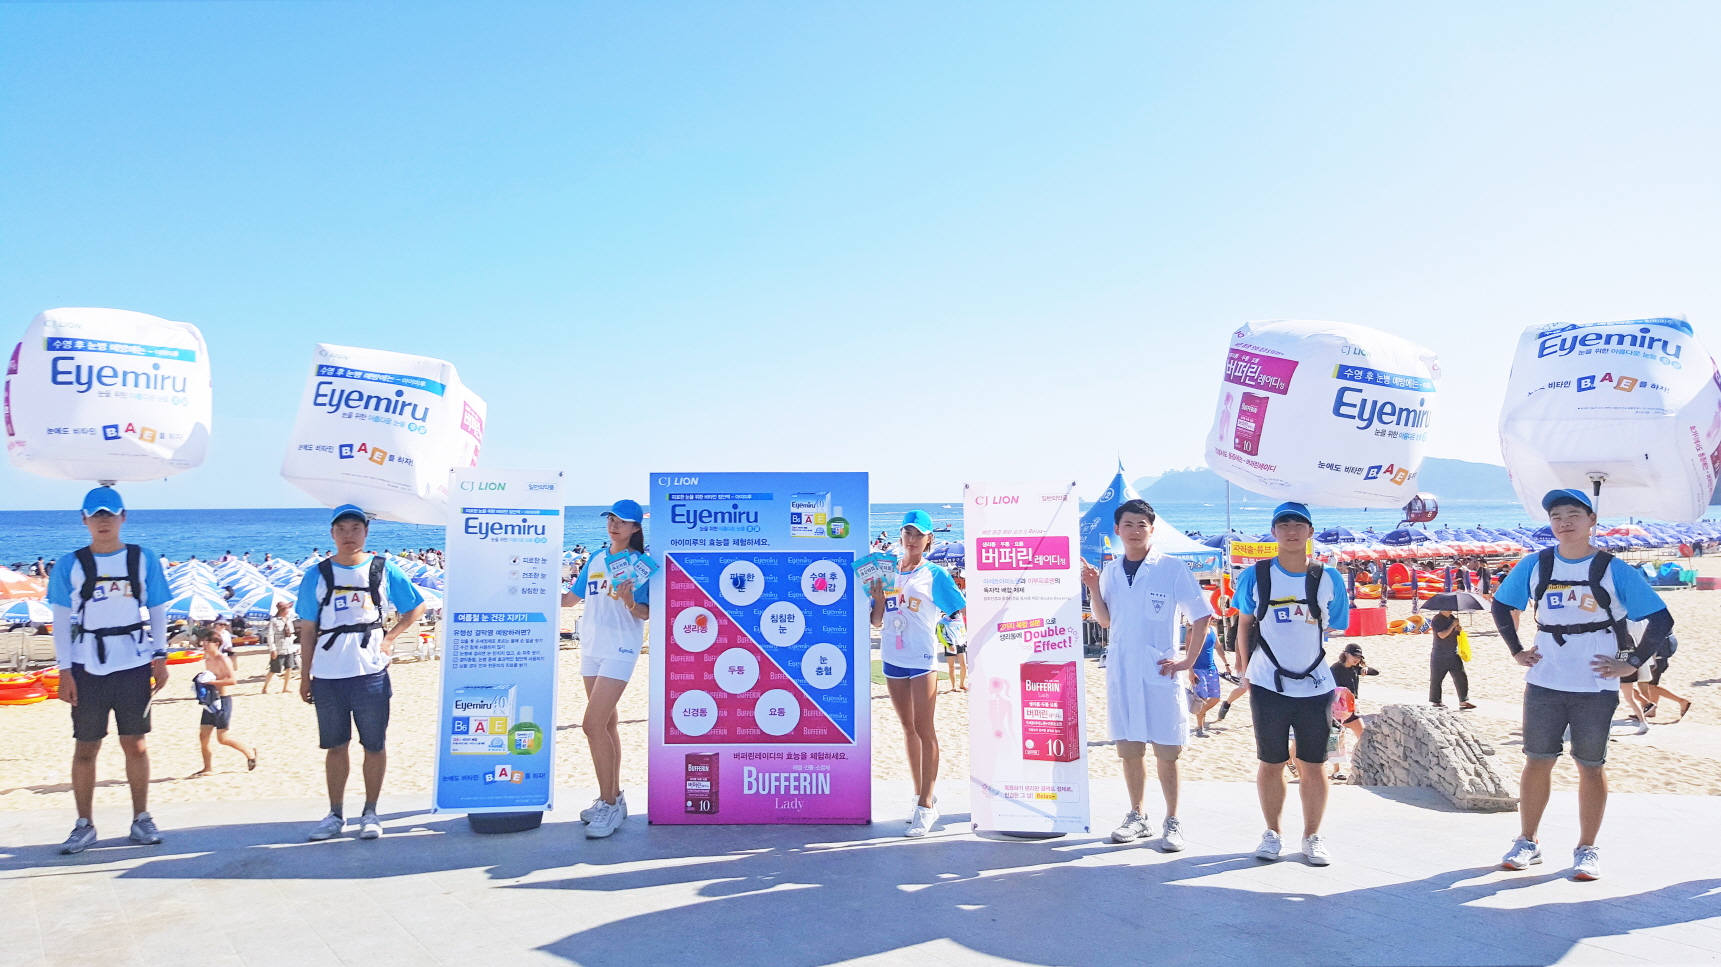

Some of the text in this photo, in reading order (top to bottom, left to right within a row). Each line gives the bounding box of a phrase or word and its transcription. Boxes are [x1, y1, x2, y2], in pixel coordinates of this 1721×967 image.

[52, 340, 72, 350] 수영
[74, 341, 86, 350] 후
[1537, 327, 1682, 359] Eyemiru
[1341, 345, 1351, 355] CJ
[51, 355, 187, 393] Eyemiru
[319, 365, 333, 376] 수영
[336, 367, 344, 377] 후
[1226, 360, 1262, 385] 버퍼린
[1344, 367, 1363, 380] 수영
[1364, 371, 1374, 381] 후
[1376, 374, 1390, 385] 눈병
[1548, 380, 1571, 389] 비타민
[313, 381, 430, 423] Eyemiru
[1332, 386, 1432, 431] Eyemiru
[460, 481, 506, 492] CJ LION
[658, 476, 699, 488] CJ LION
[791, 501, 816, 510] Eyemiru
[975, 495, 1020, 507] CJ LION
[670, 502, 759, 530] Eyemiru
[464, 516, 546, 540] Eyemiru
[670, 538, 771, 548] 아이미루의 효능을 체험하세요.
[981, 547, 1033, 568] 버퍼린
[829, 572, 838, 582] 후
[110, 581, 121, 592] A
[351, 592, 361, 603] A
[1567, 589, 1577, 601] A
[1293, 604, 1304, 616] A
[770, 613, 796, 624] 침침한
[778, 625, 788, 635] 눈
[1024, 626, 1066, 643] Double
[1033, 636, 1072, 653] Effect!
[819, 655, 829, 665] 눈
[728, 666, 745, 676] 두통
[815, 666, 832, 677] 충혈
[1025, 679, 1060, 692] BUFFERIN
[455, 700, 492, 711] Eyemiru
[682, 707, 708, 718] 신경통
[768, 707, 786, 717] 요통
[1026, 708, 1048, 719] 버퍼린
[1045, 738, 1064, 757] 10
[733, 752, 849, 761] 버퍼린레이디의 효능을 체험하세요.
[687, 763, 710, 772] BUFFERIN
[743, 766, 831, 796] BUFFERIN
[699, 799, 711, 812] 10
[774, 797, 805, 812] Lady
